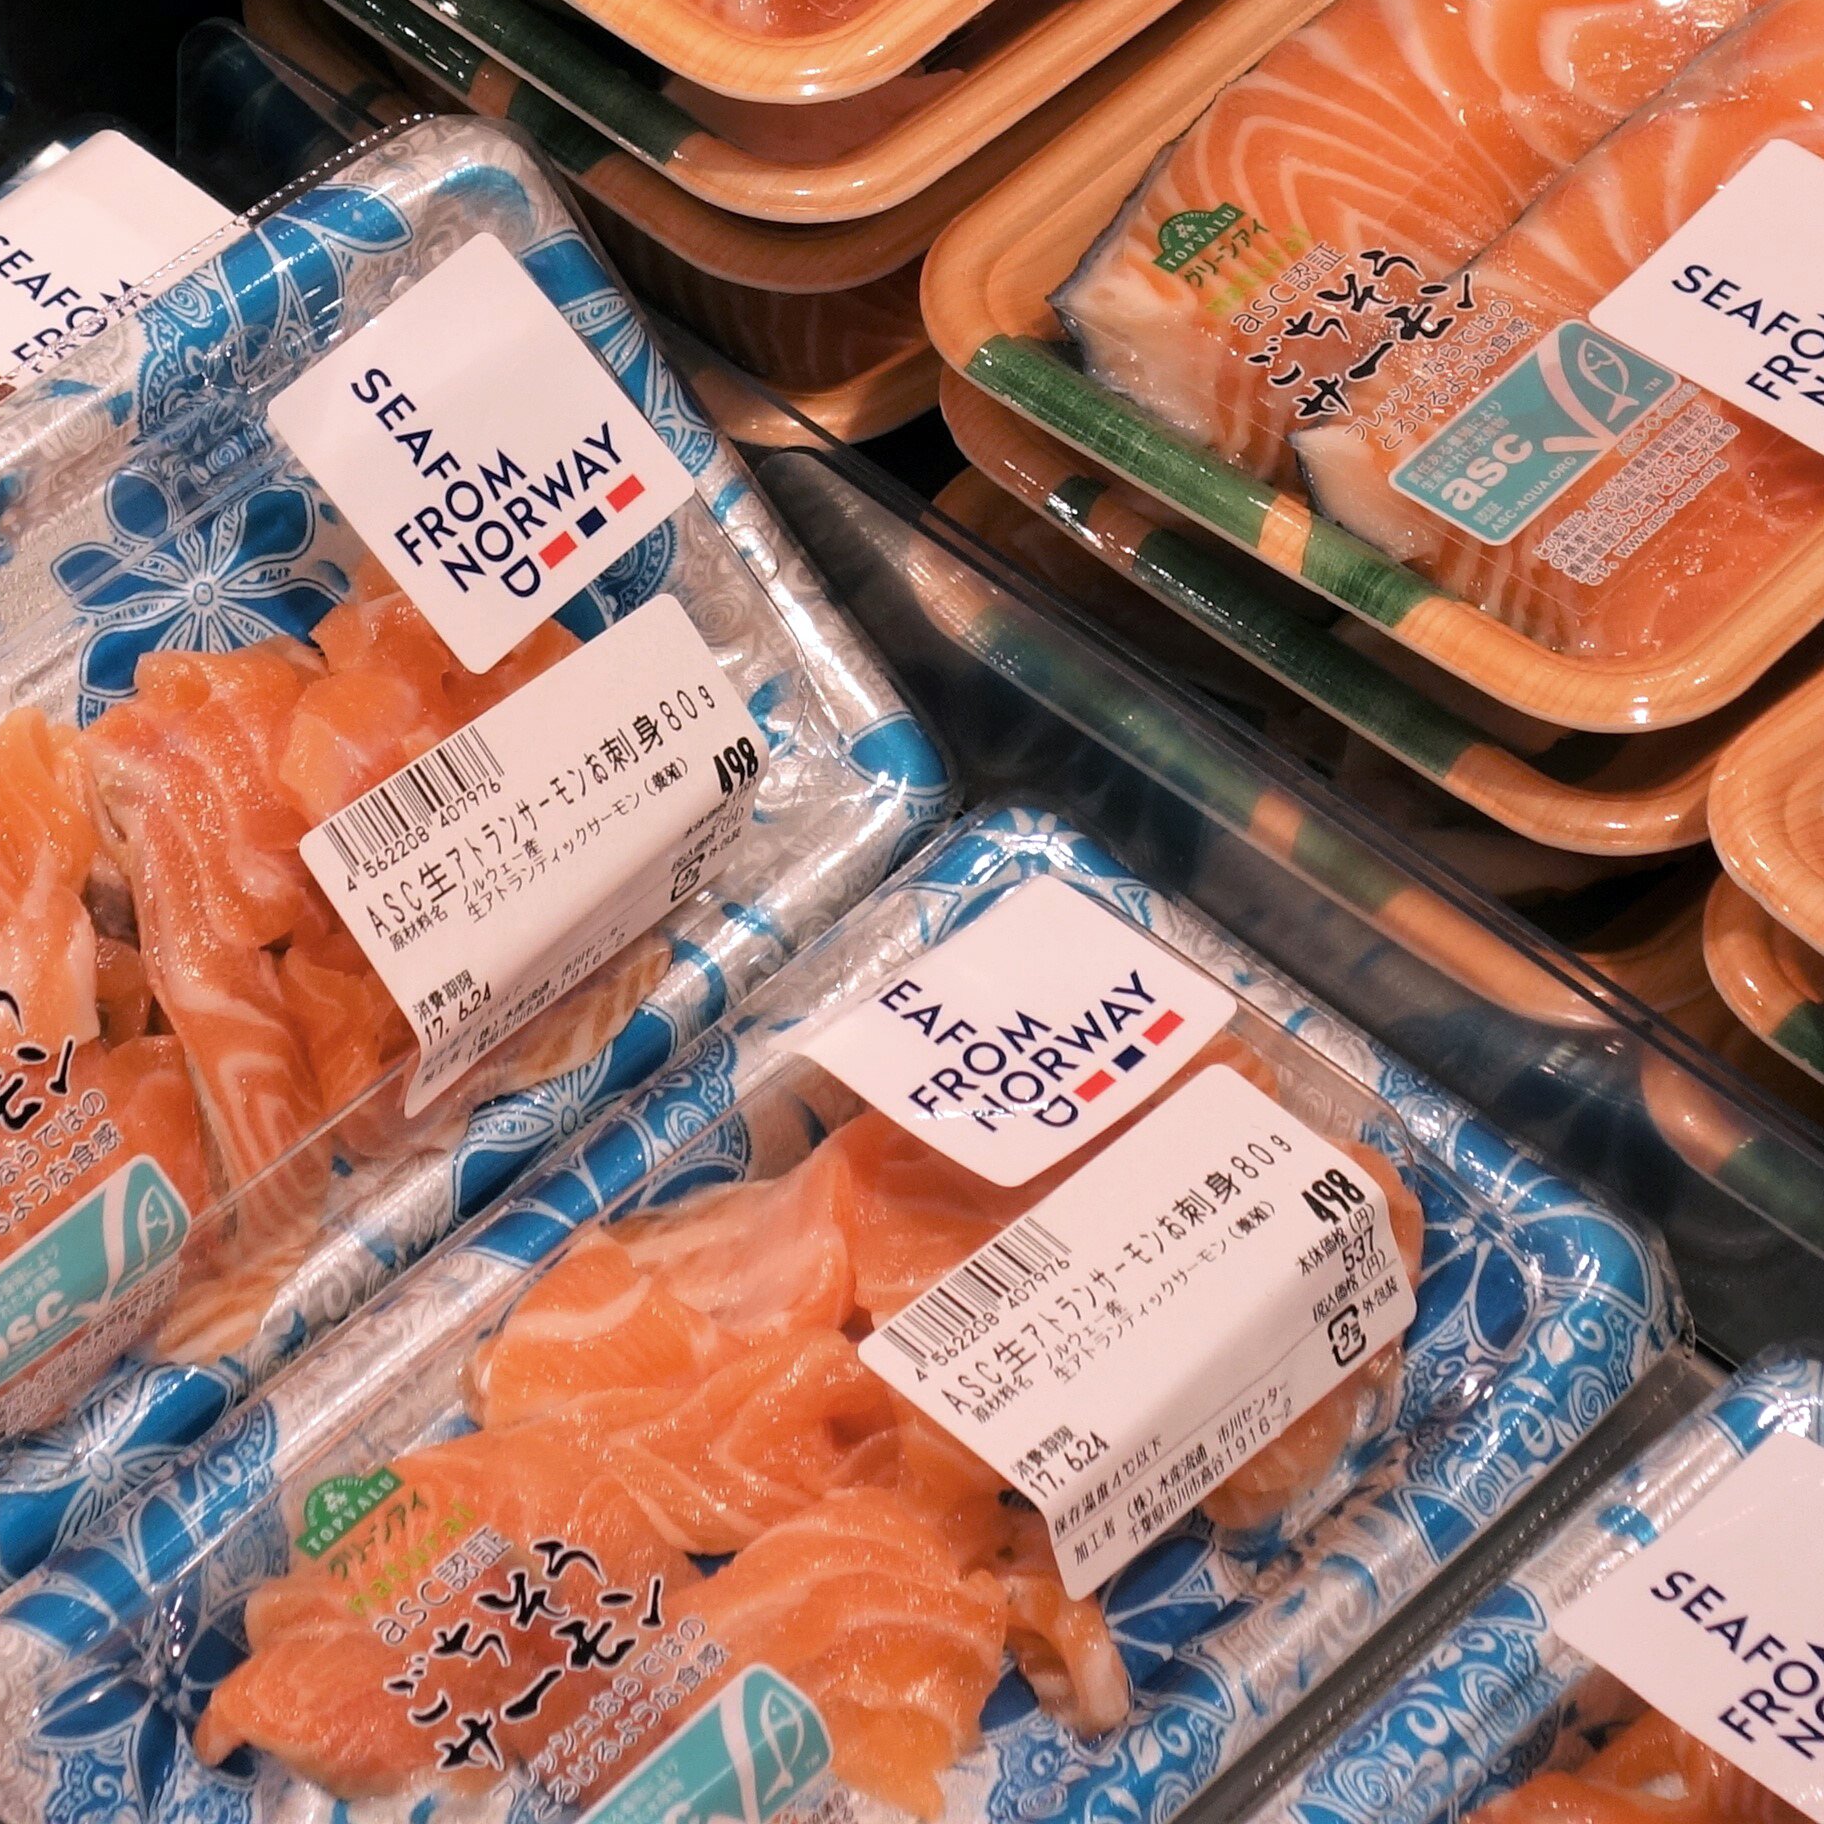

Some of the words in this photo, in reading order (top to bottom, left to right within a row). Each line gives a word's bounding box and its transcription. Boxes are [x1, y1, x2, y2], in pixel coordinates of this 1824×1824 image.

[1247, 248, 1422, 387] ごちそう
[1296, 271, 1474, 419] サーモン
[392, 448, 530, 566] FROM
[441, 421, 628, 596] NORWAY
[713, 737, 758, 794] 498
[363, 825, 430, 879] 562208
[440, 776, 501, 828] 407976
[461, 839, 540, 903] ノルウェー産
[908, 1010, 1052, 1115] FROM
[1300, 1168, 1366, 1226] 498
[1343, 1229, 1375, 1273] 537
[931, 1311, 1000, 1368] 562208
[1006, 1257, 1072, 1310] 407976
[973, 1376, 1034, 1424] 原材料名
[1044, 1302, 1128, 1371] ノルウェー産
[1011, 1426, 1078, 1478] 消費期限
[385, 1540, 608, 1725] ごちそう
[436, 1576, 663, 1772] サーモン
